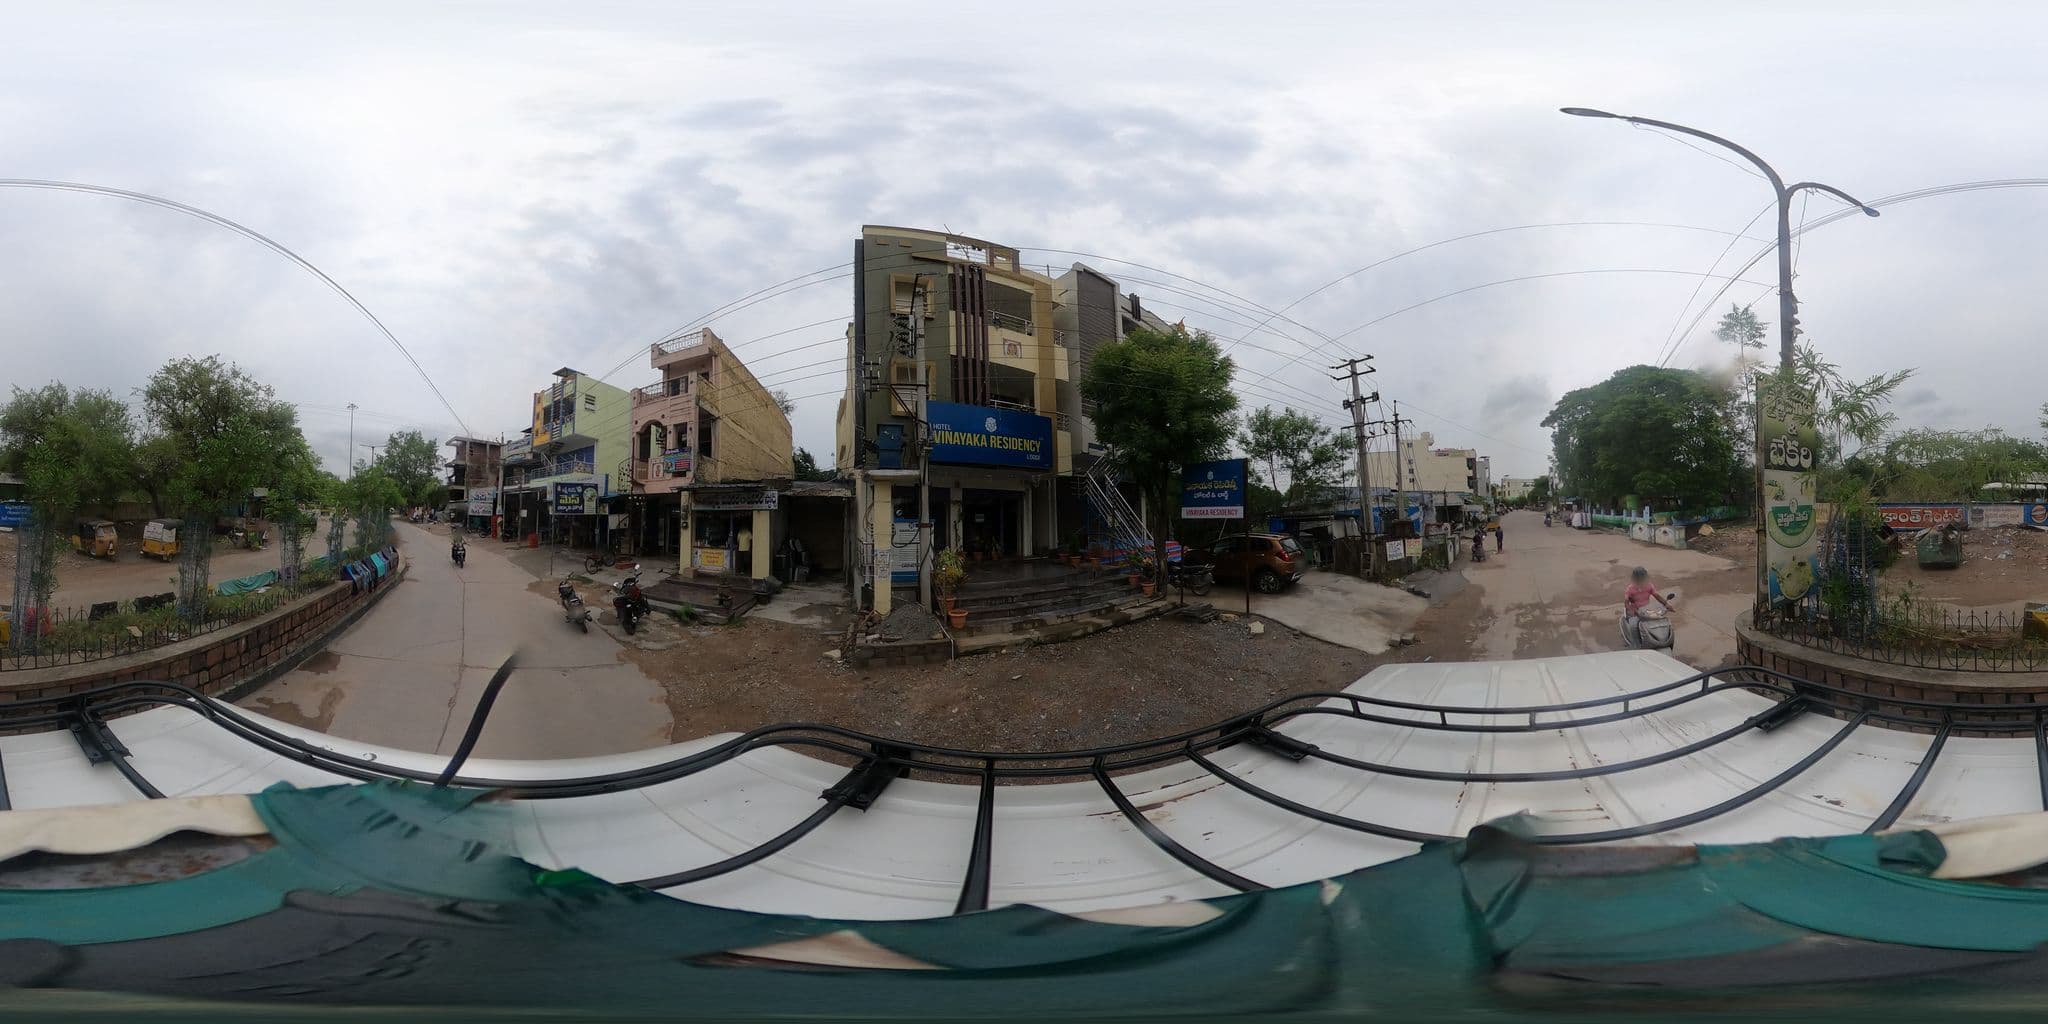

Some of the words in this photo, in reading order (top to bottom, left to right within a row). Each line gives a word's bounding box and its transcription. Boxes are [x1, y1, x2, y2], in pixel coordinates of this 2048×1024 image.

[933, 423, 951, 431] HOTEL
[934, 430, 988, 447] VINAYAKA
[990, 435, 1041, 453] RESIDENCY
